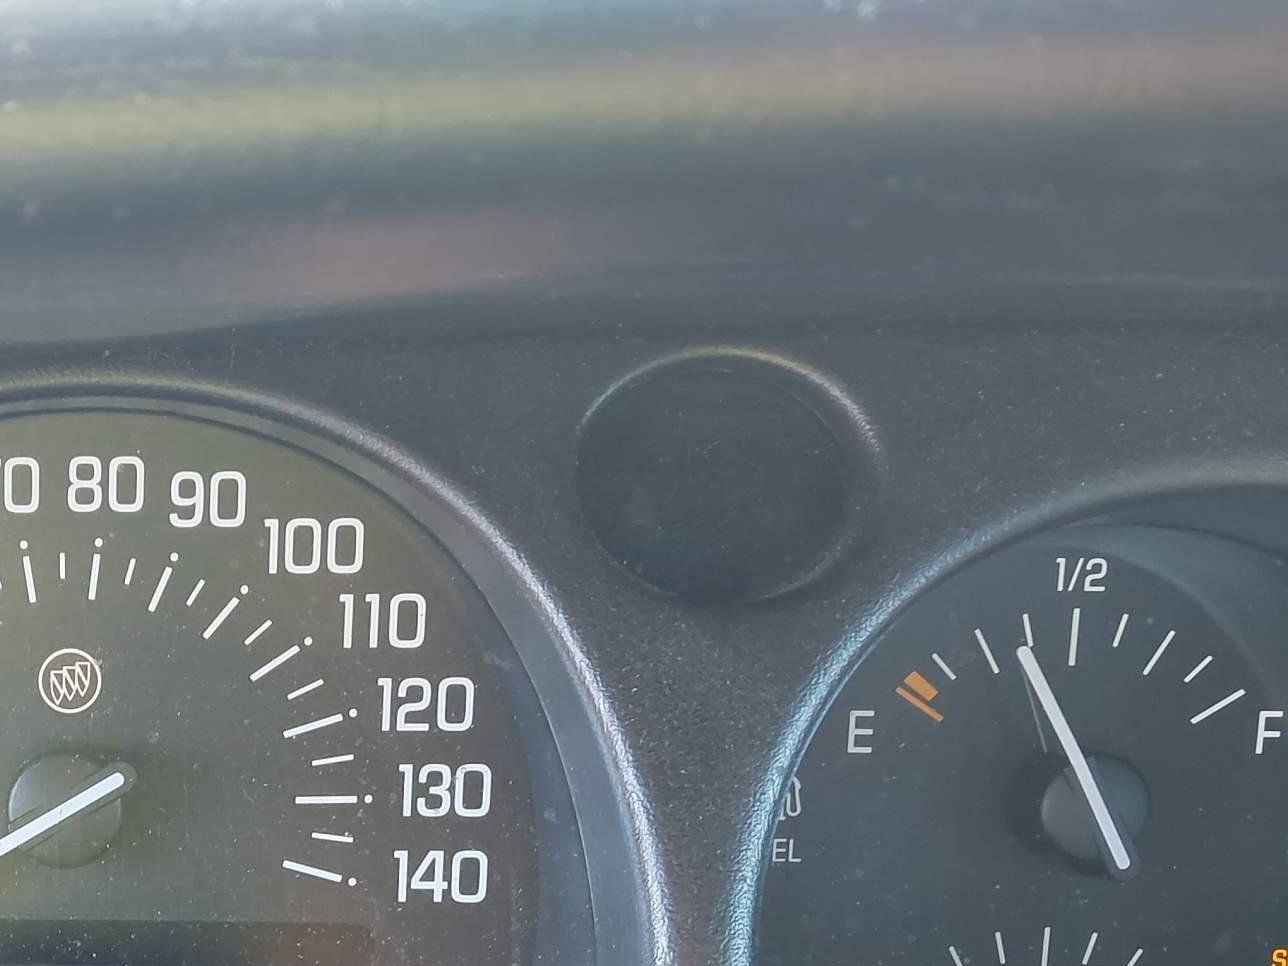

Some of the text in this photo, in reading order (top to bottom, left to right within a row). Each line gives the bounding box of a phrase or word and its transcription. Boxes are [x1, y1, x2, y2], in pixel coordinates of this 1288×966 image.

[67, 455, 145, 513] 80
[168, 470, 247, 528] 90
[263, 517, 365, 575] 100
[1055, 557, 1108, 593] 1/2
[339, 592, 427, 650] 110
[377, 676, 475, 733] 120
[846, 709, 876, 754] E
[1255, 710, 1285, 755] F
[398, 763, 493, 819] 130
[393, 850, 489, 904] 140
